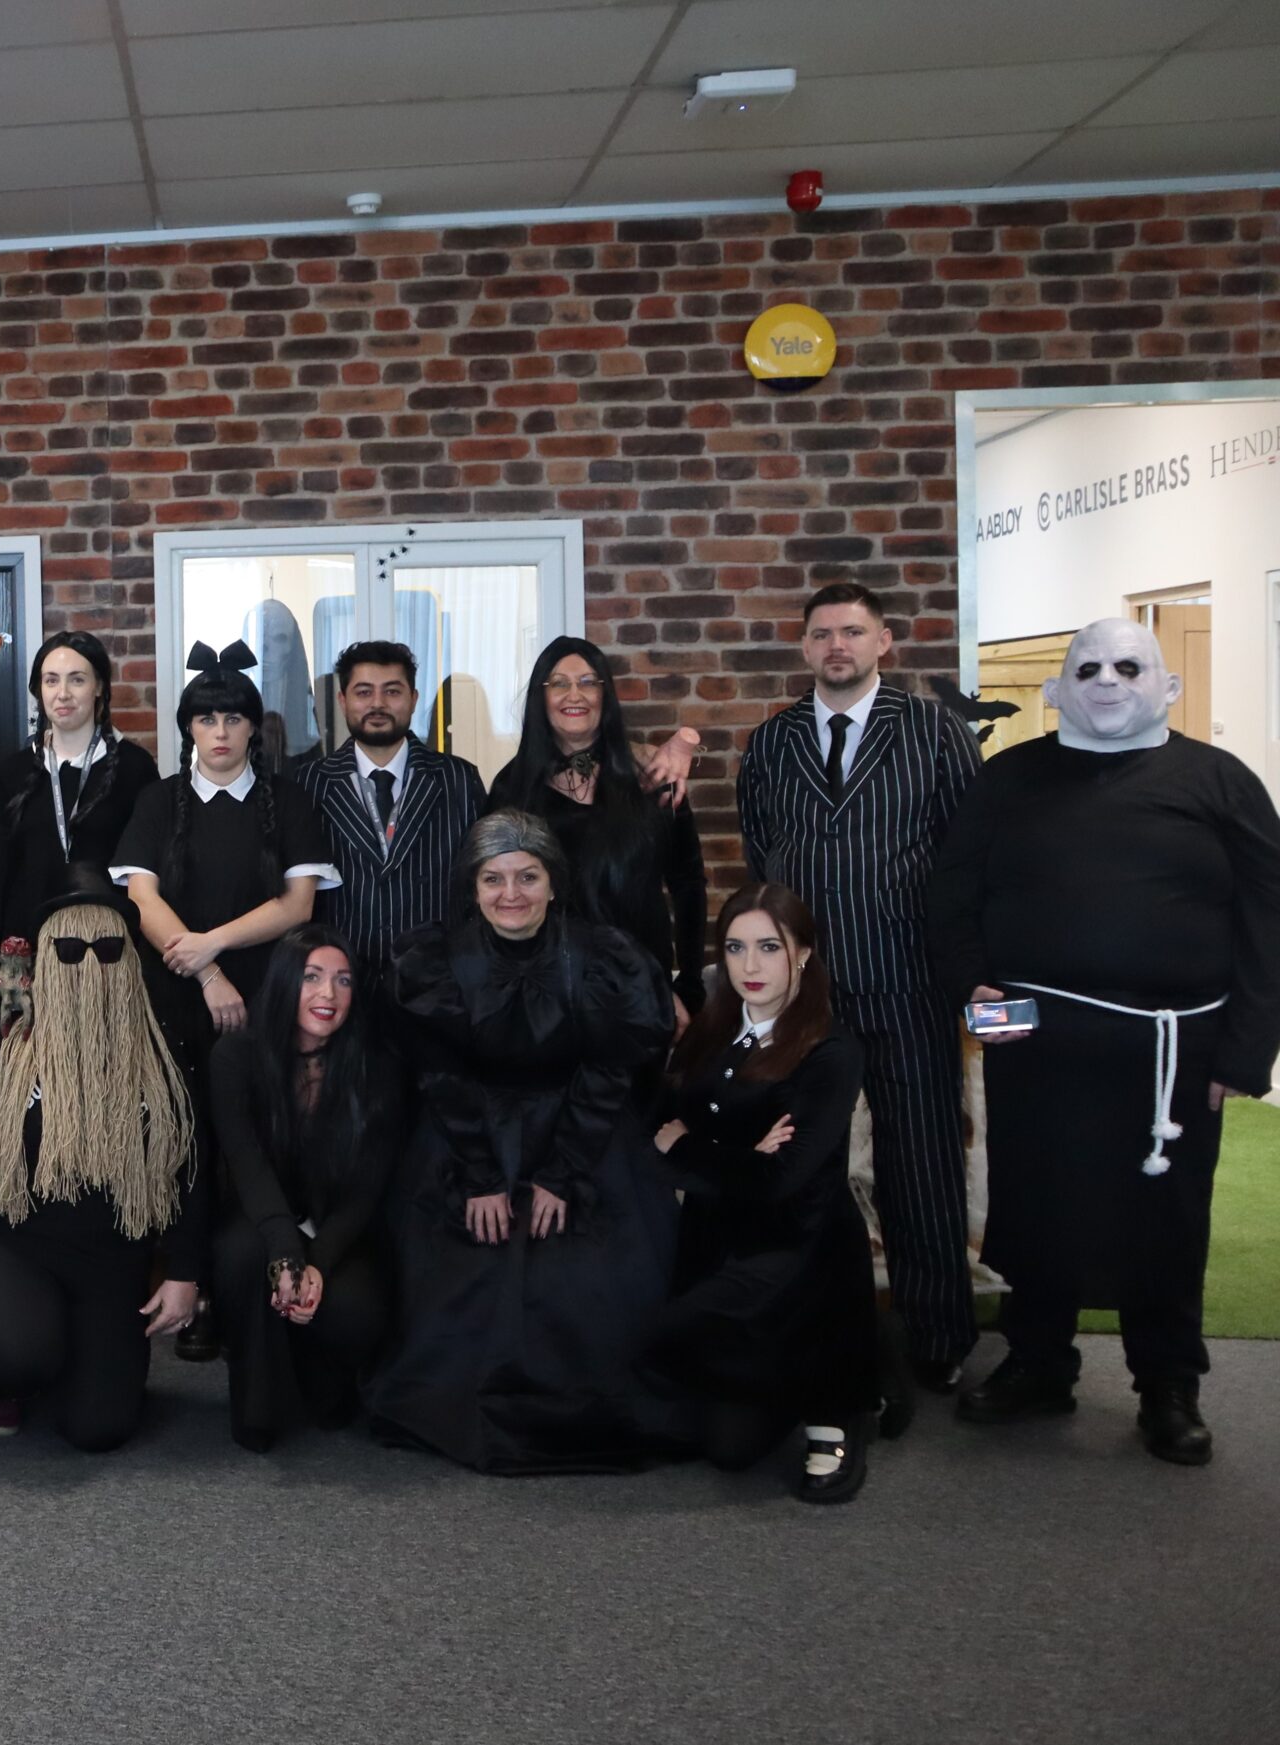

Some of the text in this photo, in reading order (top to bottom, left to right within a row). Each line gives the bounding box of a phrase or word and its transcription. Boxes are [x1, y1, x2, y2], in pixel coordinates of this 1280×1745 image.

[770, 336, 814, 356] Yale
[1055, 453, 1191, 522] CARLISLE BRASS
[986, 505, 1023, 541] ABLOY
